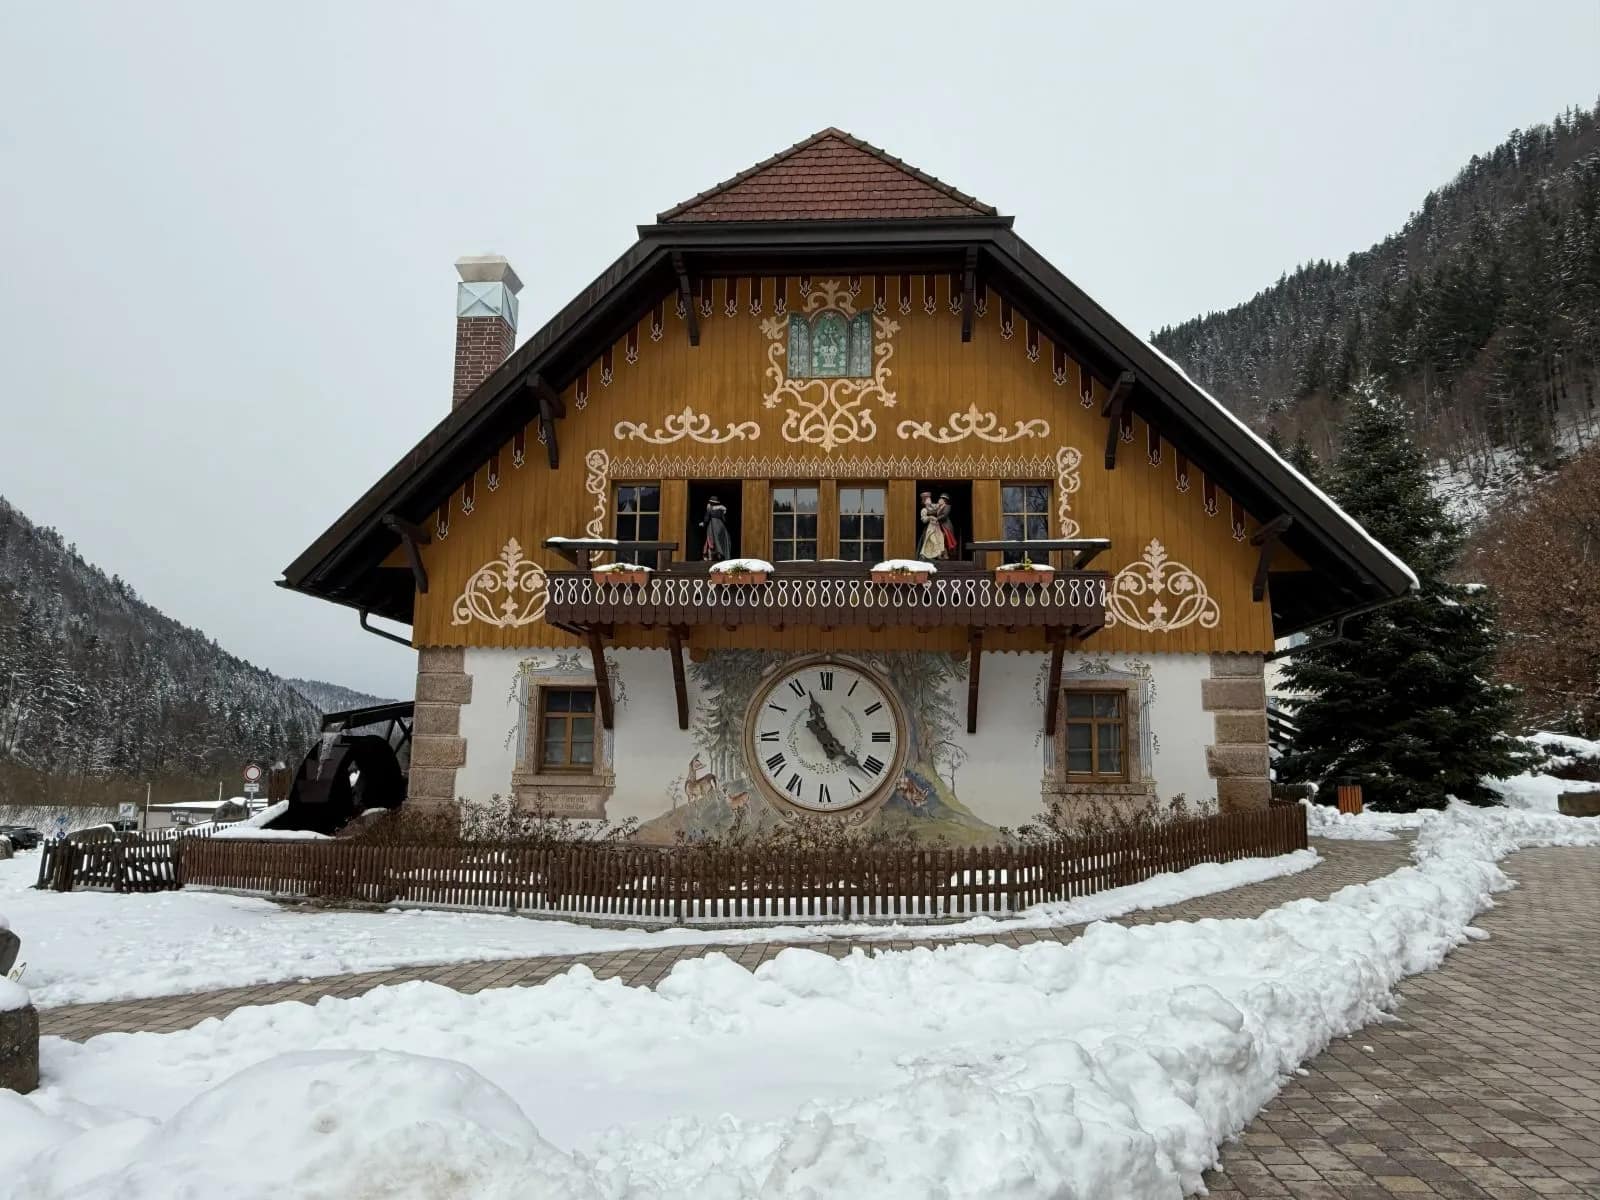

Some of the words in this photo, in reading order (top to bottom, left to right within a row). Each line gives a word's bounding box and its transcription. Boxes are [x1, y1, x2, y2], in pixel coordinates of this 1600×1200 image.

[789, 679, 806, 697] XI
[820, 671, 833, 690] XII
[848, 680, 859, 697] I
[864, 702, 882, 716] II
[761, 731, 779, 741] IX
[872, 732, 890, 742] III
[766, 752, 787, 777] VIII
[785, 773, 802, 797] VII
[819, 783, 831, 802] VI
[849, 778, 862, 795] V
